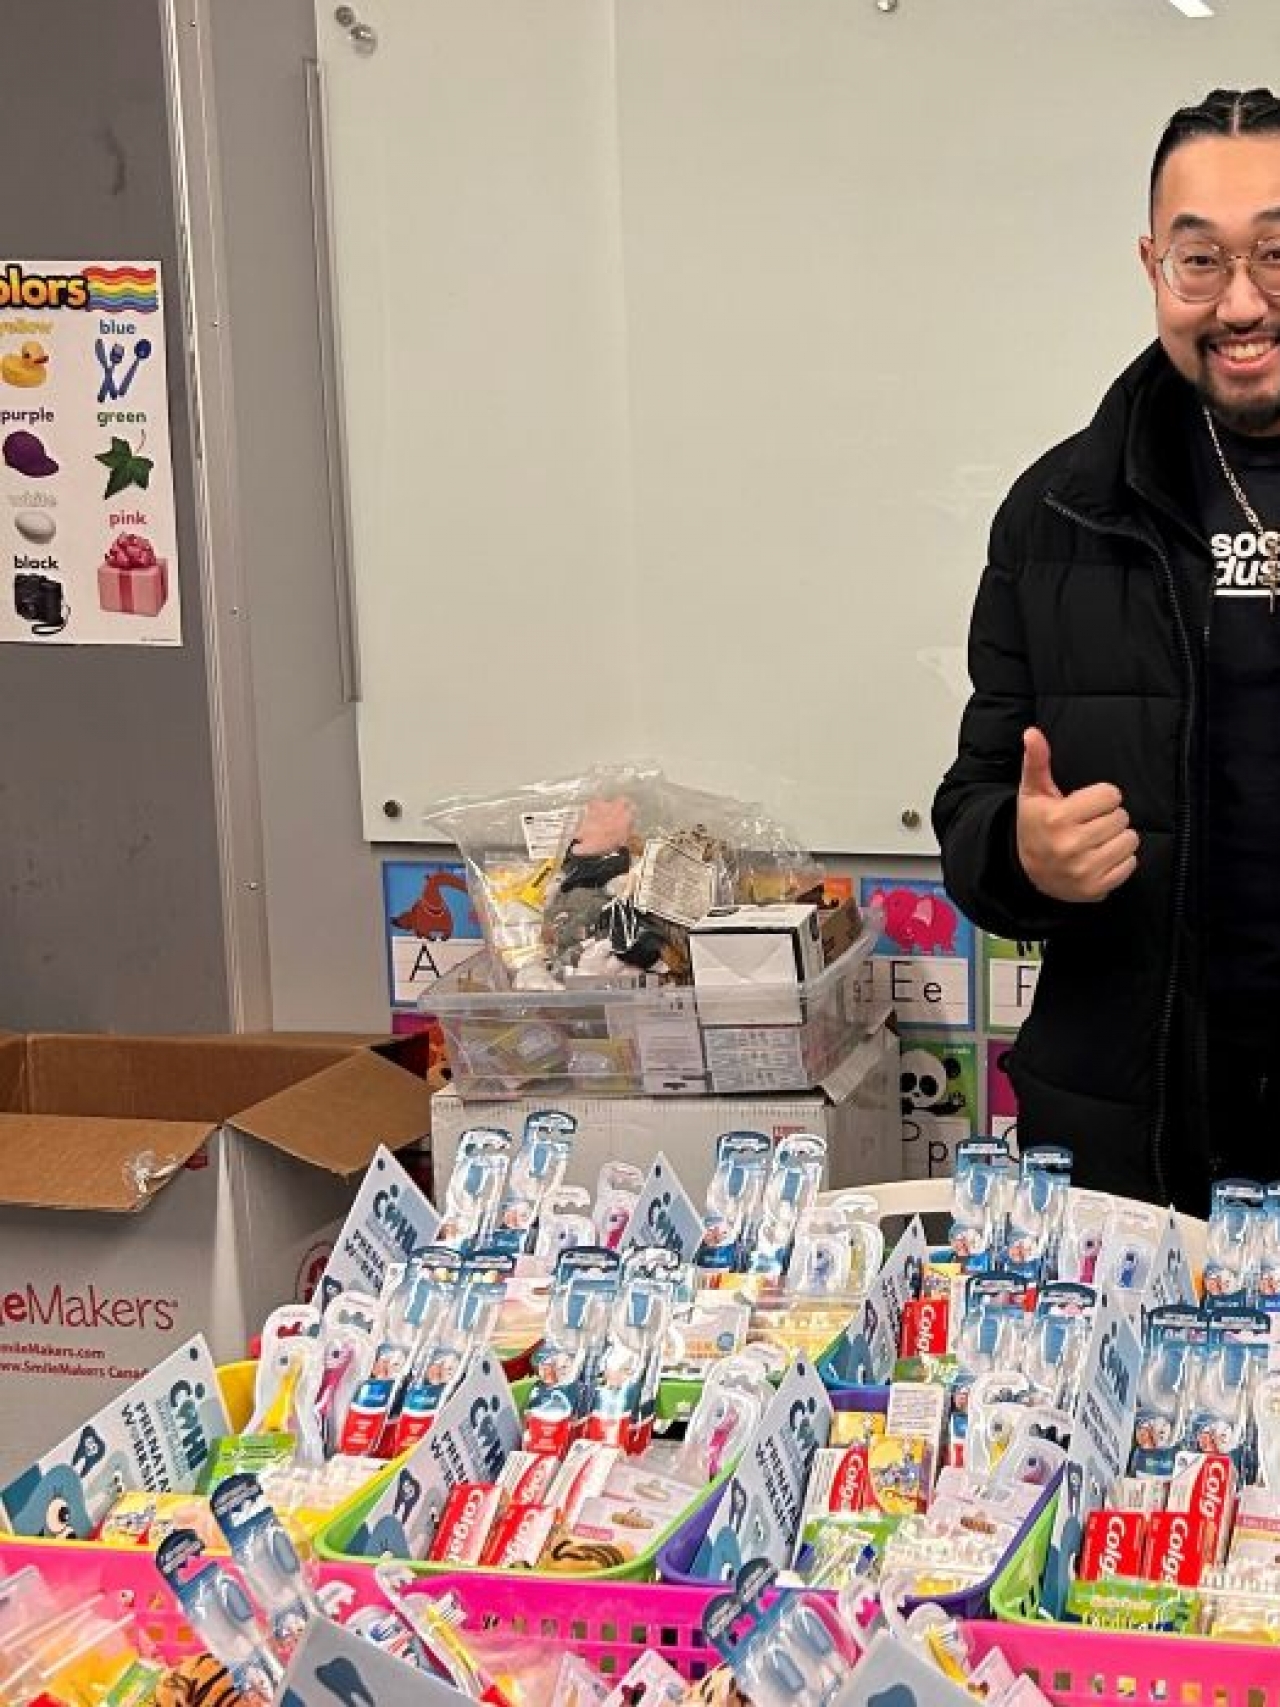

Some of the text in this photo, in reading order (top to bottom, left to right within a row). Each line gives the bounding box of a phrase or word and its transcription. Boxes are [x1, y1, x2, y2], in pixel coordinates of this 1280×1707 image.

[99, 319, 136, 335] blue
[0, 407, 54, 425] purple
[97, 411, 147, 427] green
[109, 509, 147, 528] pink
[14, 555, 59, 569] black
[410, 944, 441, 981] A
[0, 1282, 175, 1331] eMakers
